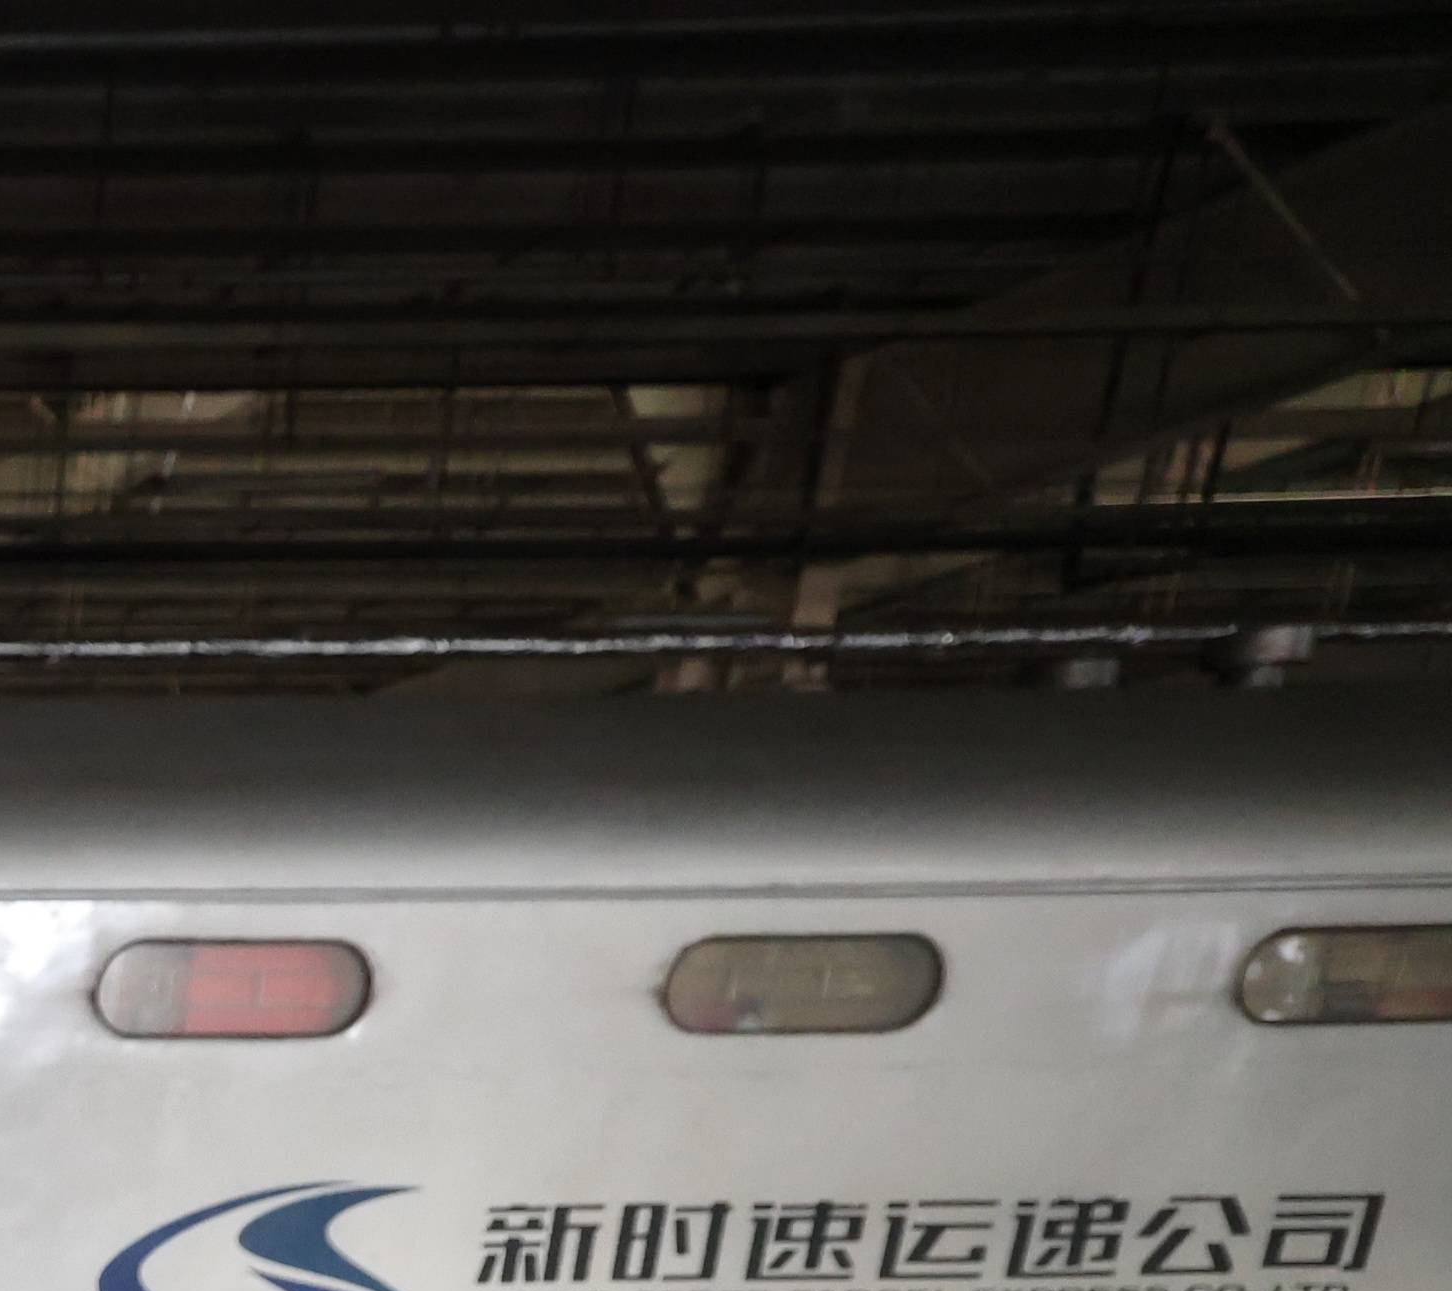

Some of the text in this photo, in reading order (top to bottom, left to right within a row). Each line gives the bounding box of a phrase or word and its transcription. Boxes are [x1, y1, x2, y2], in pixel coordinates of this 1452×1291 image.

[476, 1193, 1386, 1284] 新时速运递公司
